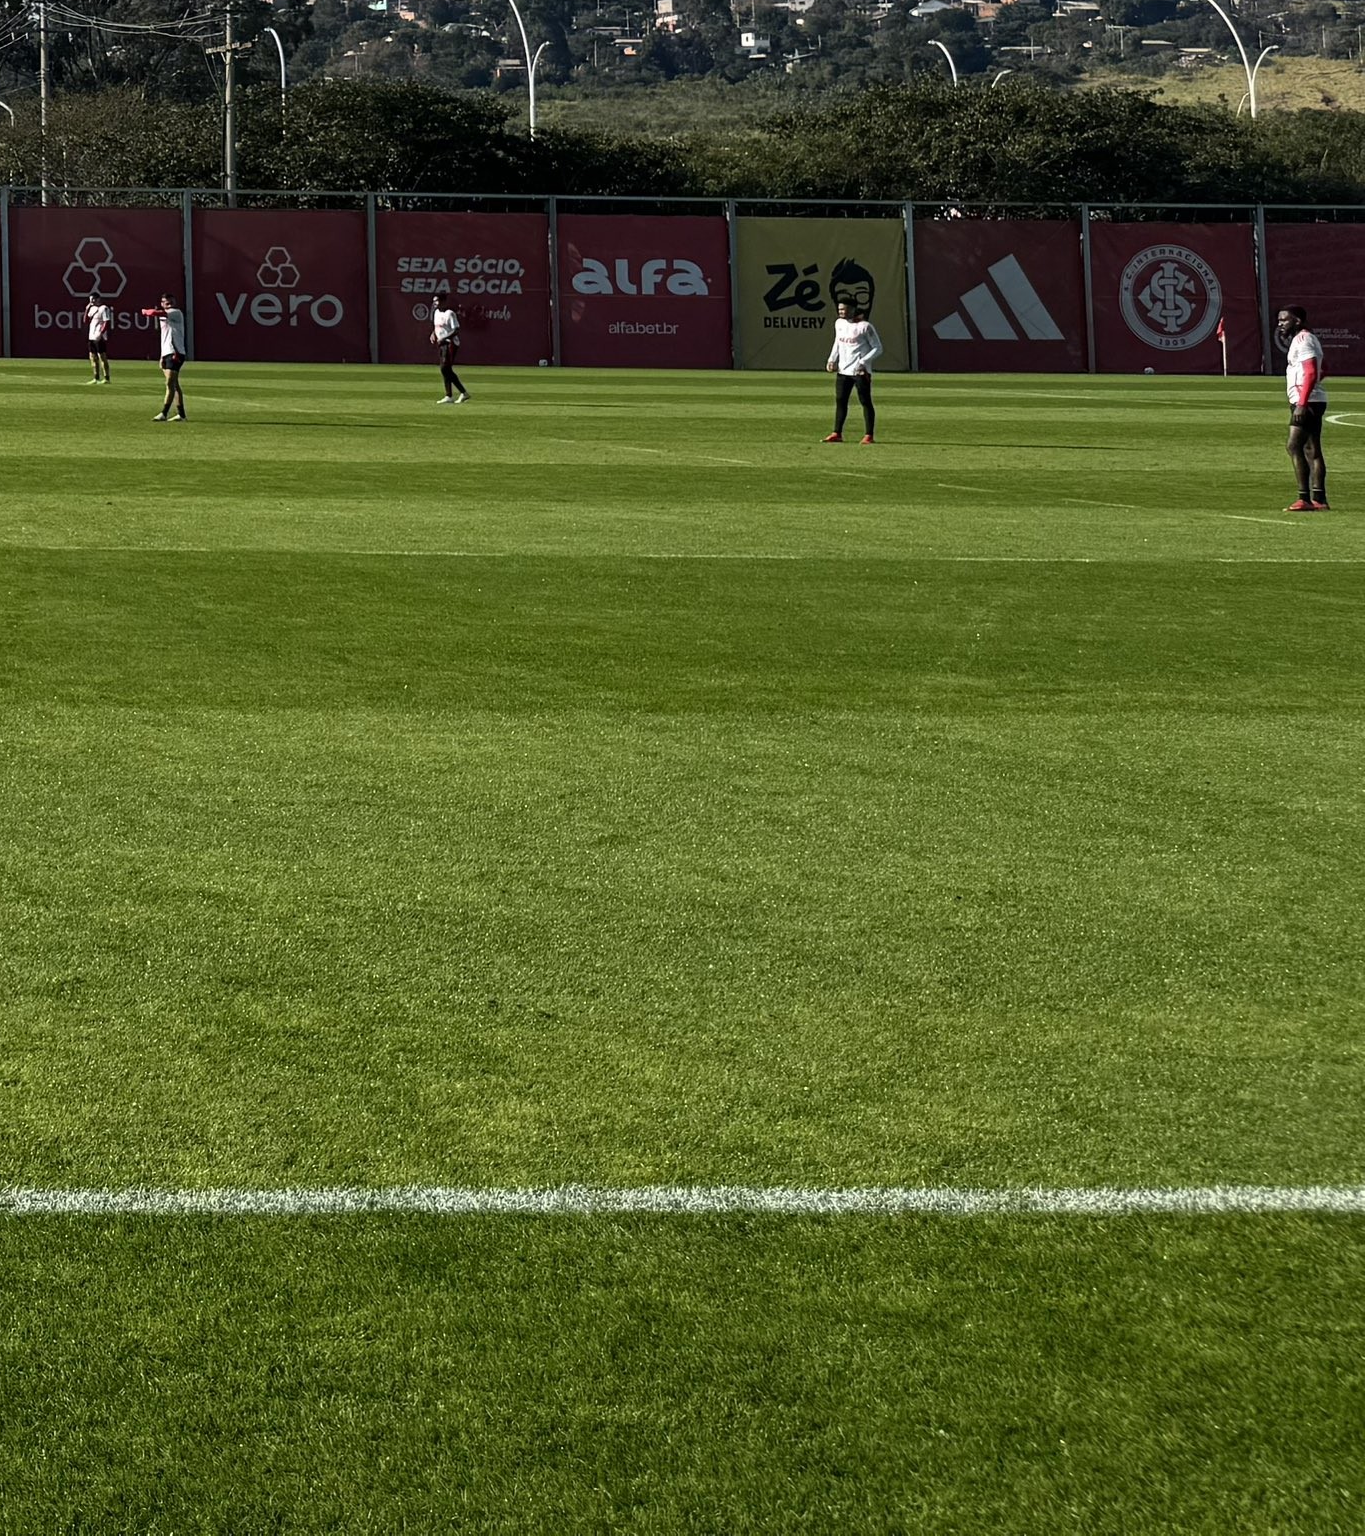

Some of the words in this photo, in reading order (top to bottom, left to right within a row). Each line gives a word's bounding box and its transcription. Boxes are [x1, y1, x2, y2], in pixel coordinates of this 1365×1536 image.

[397, 257, 448, 273] SEJA
[453, 255, 525, 277] SÓCIO,
[572, 258, 709, 296] alfa
[401, 278, 451, 293] SEJA
[457, 275, 523, 294] SÓCIA
[763, 263, 826, 312] Zé
[215, 292, 344, 328] vero
[609, 322, 679, 334] alfa.bet.br
[764, 317, 826, 329] DELIVERY
